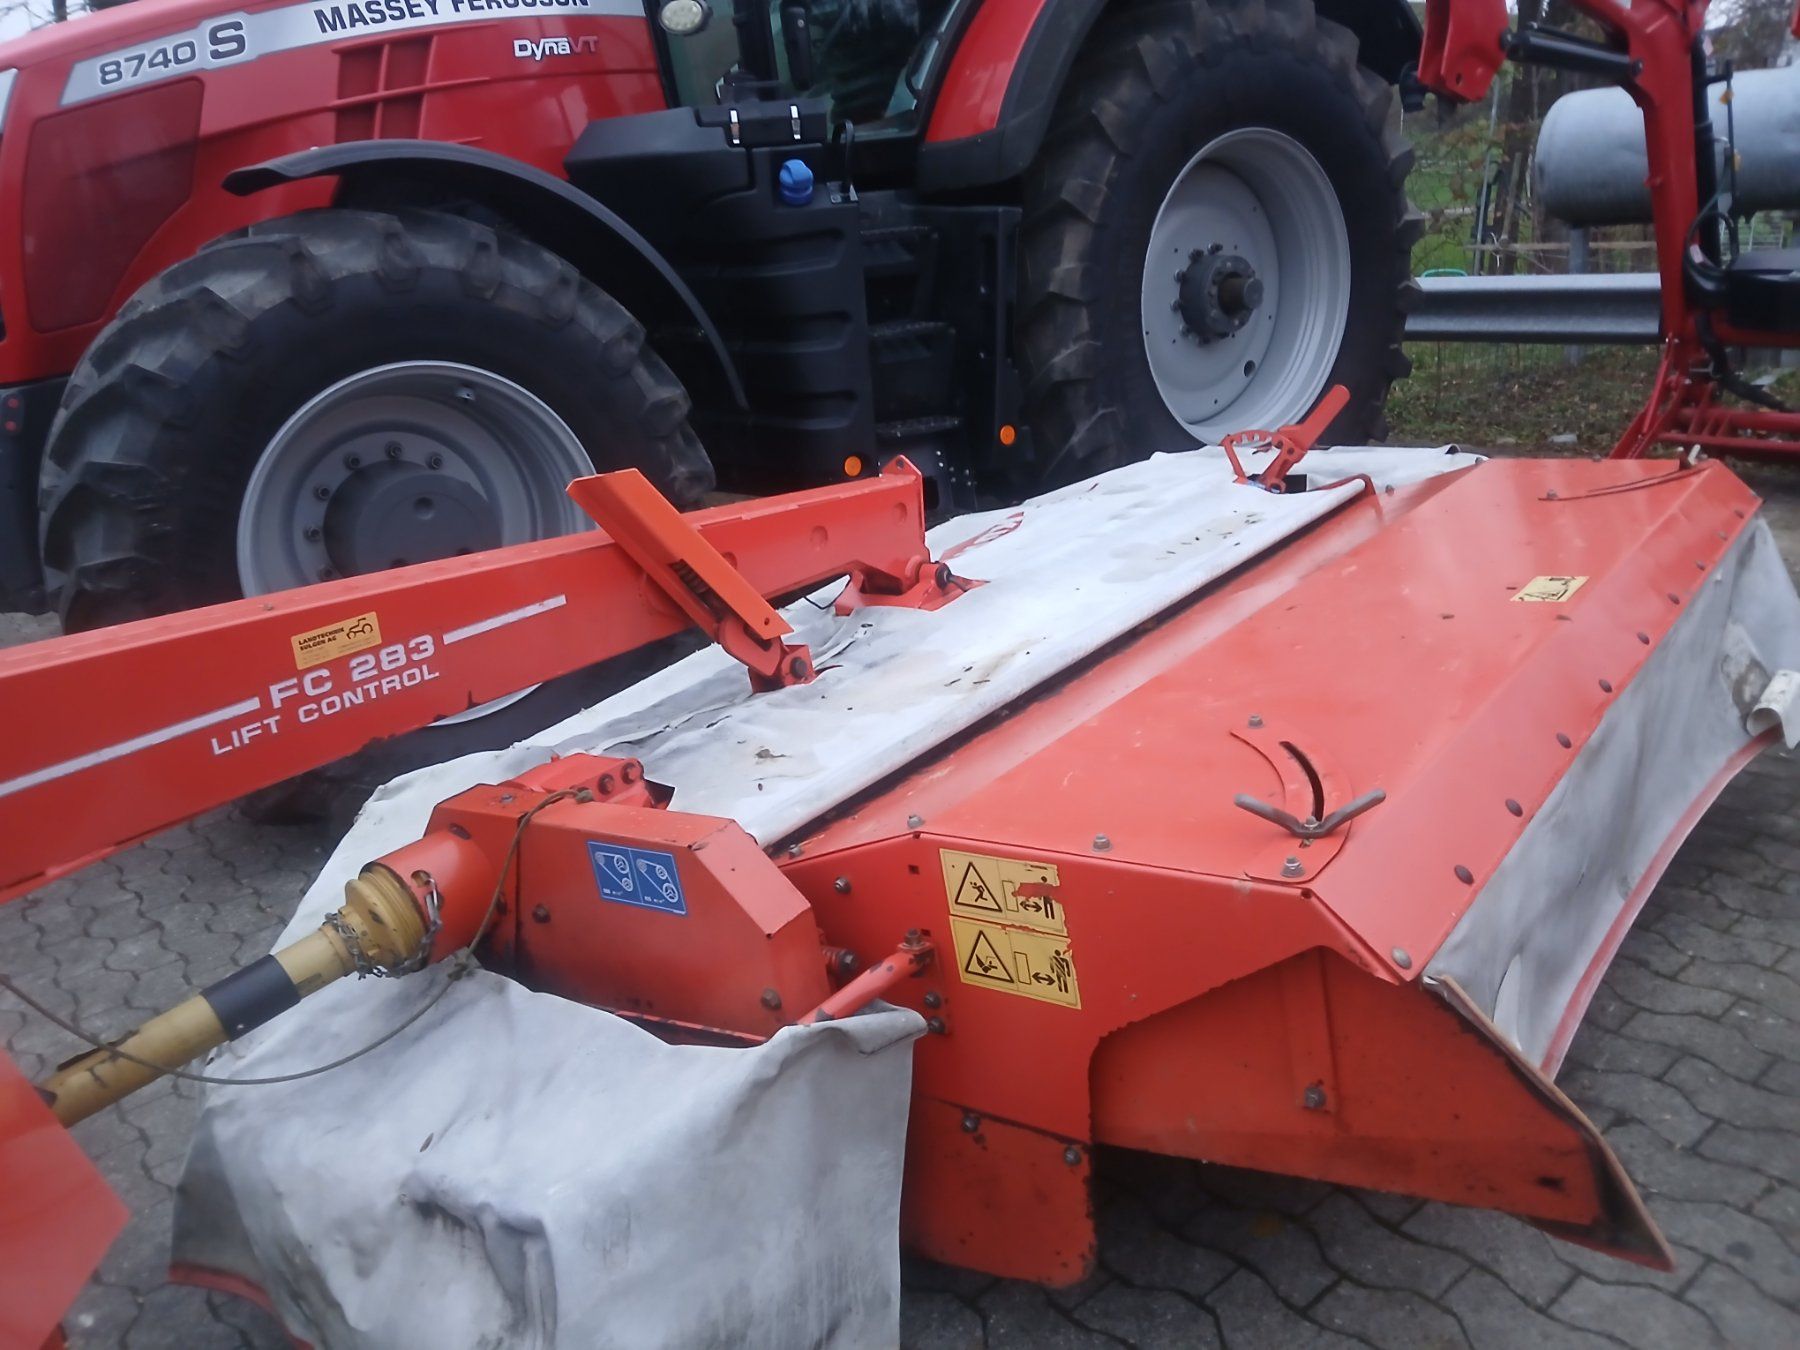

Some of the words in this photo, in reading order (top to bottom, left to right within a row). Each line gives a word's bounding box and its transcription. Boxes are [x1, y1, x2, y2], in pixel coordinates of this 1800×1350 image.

[314, 0, 438, 33] MASSEY
[99, 40, 197, 85] 8740
[208, 21, 246, 60] S
[269, 668, 332, 709] FC
[349, 634, 435, 682] 283
[211, 715, 281, 755] LIFT
[298, 664, 439, 723] CONTROL
